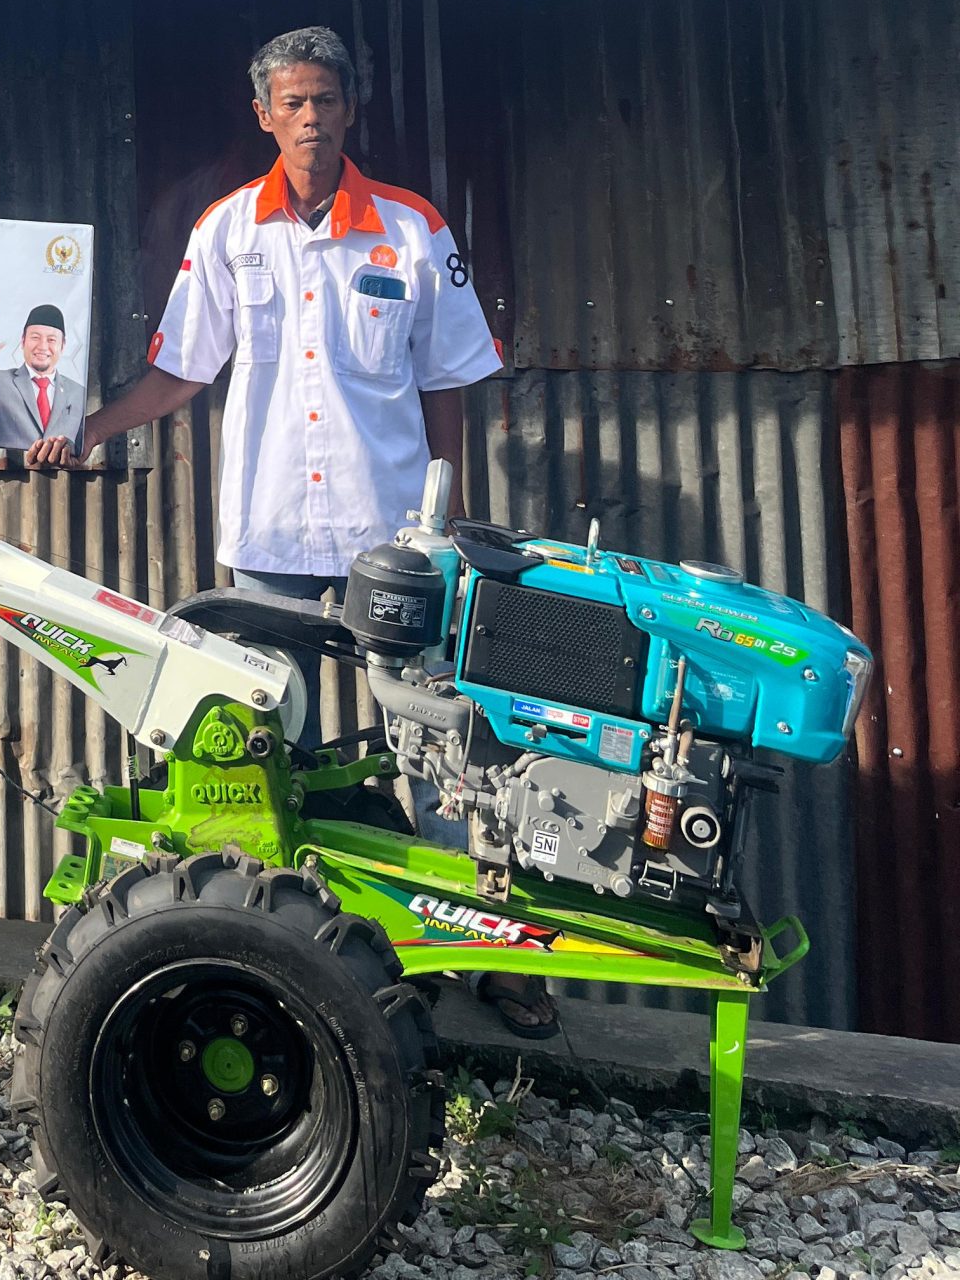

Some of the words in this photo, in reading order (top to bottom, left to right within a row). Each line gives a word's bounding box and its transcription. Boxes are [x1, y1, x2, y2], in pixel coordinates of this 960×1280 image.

[446, 253, 469, 288] 8
[661, 593, 706, 609] SUPER
[709, 604, 759, 622] POWER
[20, 613, 96, 656] QUICK
[32, 632, 88, 665] IMPALA
[521, 704, 541, 713] JALAN
[572, 715, 590, 727] STOP
[190, 783, 262, 805] QUICK
[534, 835, 557, 853] SNI
[408, 893, 527, 943] QUICK
[424, 917, 508, 947] IMPALA
